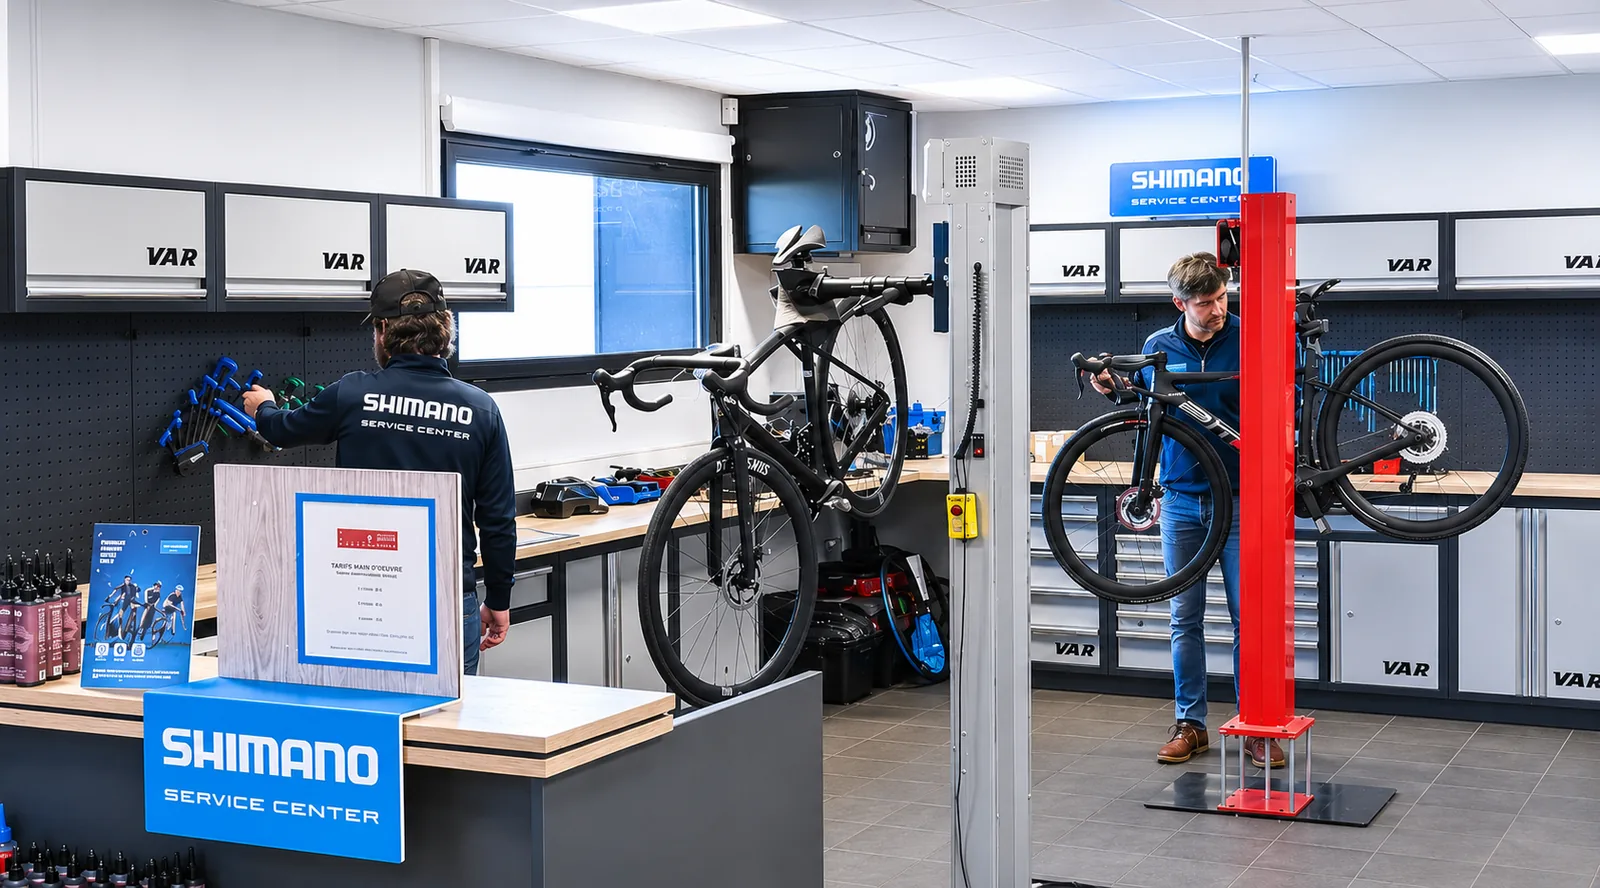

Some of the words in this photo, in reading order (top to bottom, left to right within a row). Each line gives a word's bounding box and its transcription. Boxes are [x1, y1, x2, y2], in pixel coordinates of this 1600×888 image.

[1131, 197, 1187, 206] SERVICE
[146, 246, 198, 267] VAR
[322, 252, 365, 271] VAR
[1387, 258, 1432, 272] VAR
[1564, 255, 1600, 269] VA
[464, 257, 500, 274] VAR
[1061, 265, 1100, 277] VAR
[362, 393, 473, 425] SHIMANO
[361, 419, 414, 432] SERVICE
[417, 426, 471, 440] CENTER
[1054, 641, 1096, 657] VAR
[1382, 660, 1430, 677] VAR
[1553, 671, 1600, 689] VAR
[162, 727, 379, 786] SHIMANO
[164, 788, 265, 812] SERVICE
[273, 800, 379, 825] CENTER
